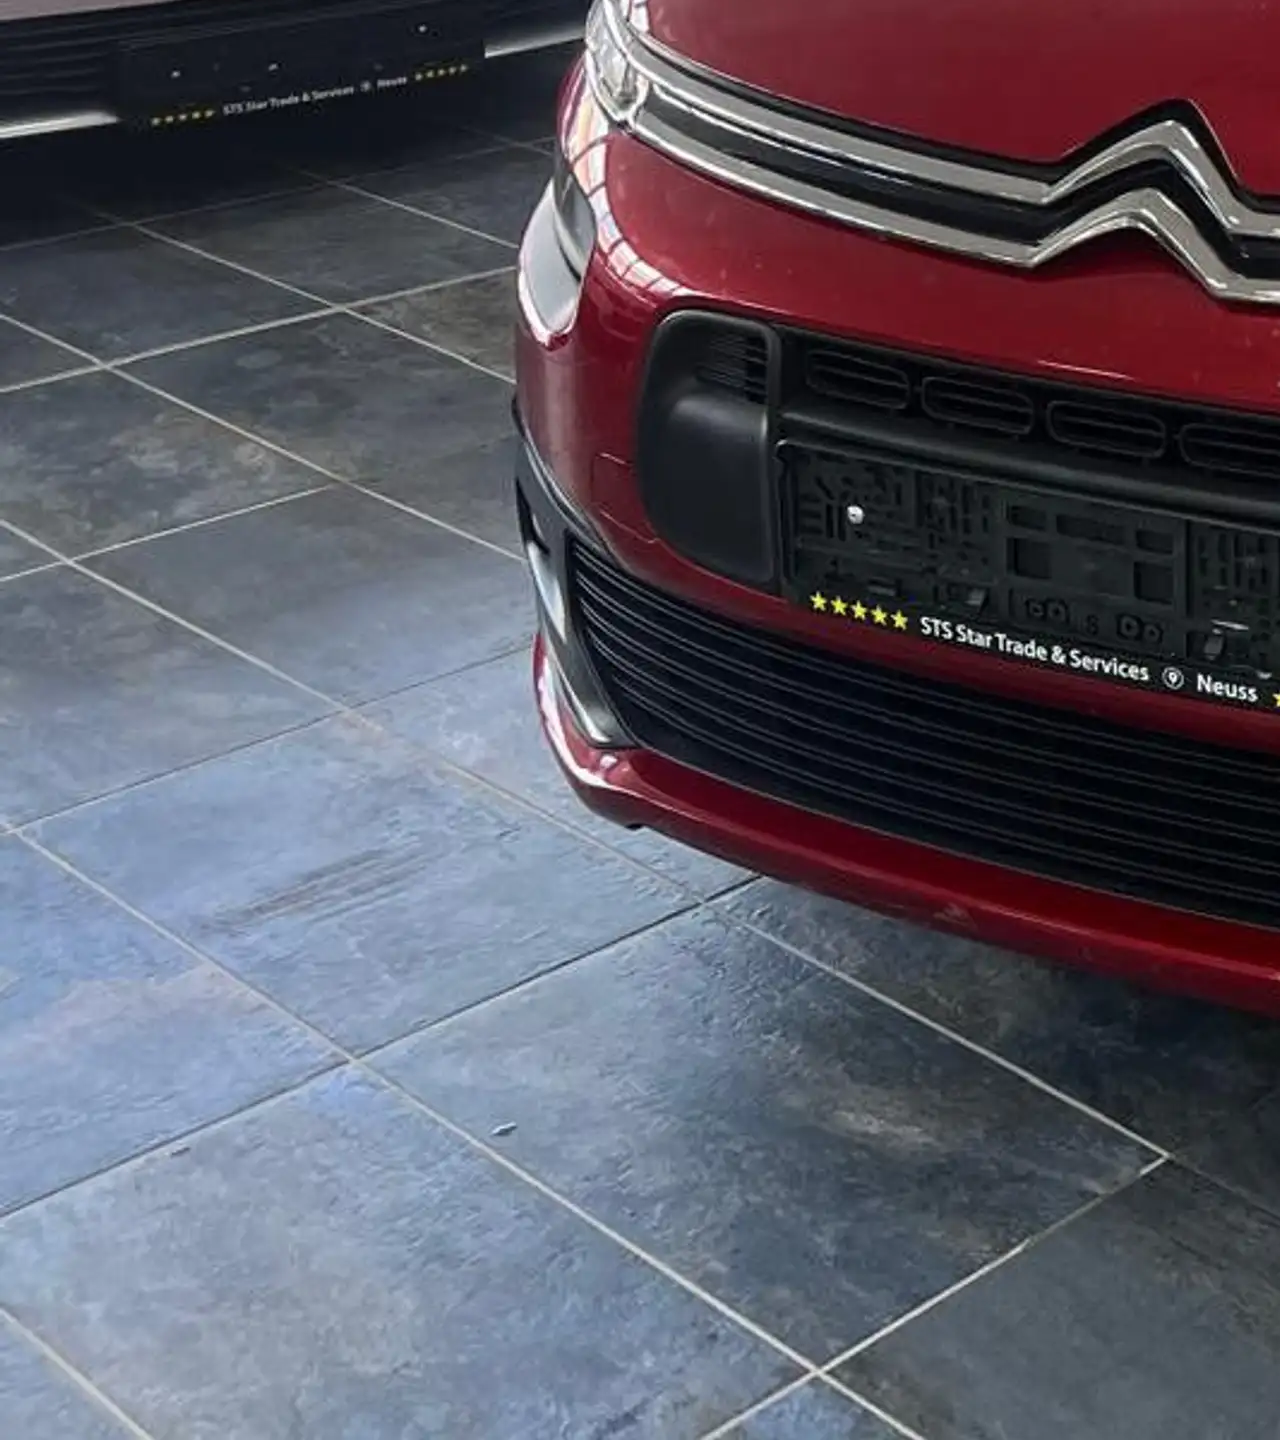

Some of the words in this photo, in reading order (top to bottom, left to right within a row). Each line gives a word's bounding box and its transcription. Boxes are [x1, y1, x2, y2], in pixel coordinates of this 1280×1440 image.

[920, 616, 953, 641] STS
[955, 624, 993, 649] Star
[996, 632, 1049, 662] Trade
[1050, 645, 1068, 665] &
[1069, 649, 1150, 682] Services
[1196, 673, 1259, 703] Neuss
